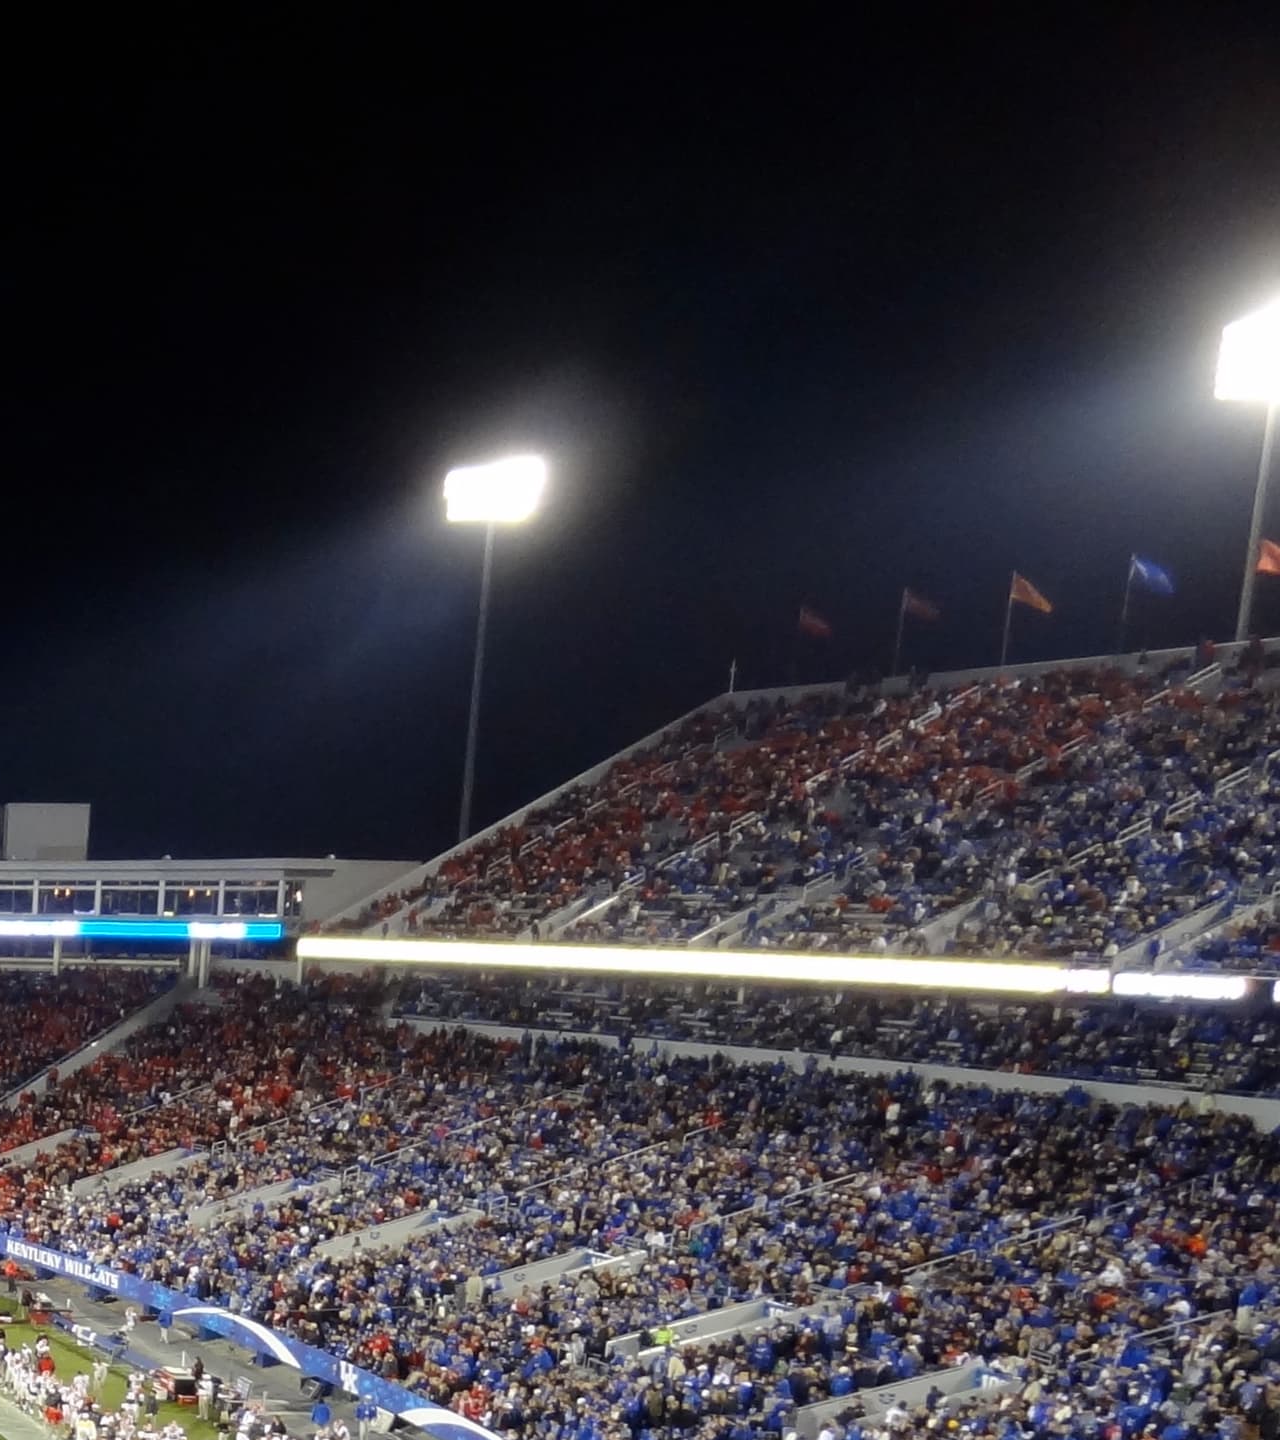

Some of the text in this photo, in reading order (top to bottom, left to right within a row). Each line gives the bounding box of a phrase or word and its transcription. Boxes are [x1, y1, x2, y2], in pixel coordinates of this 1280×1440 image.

[6, 1239, 120, 1290] KENTUCKY WILDATS
[340, 1361, 358, 1394] UK
